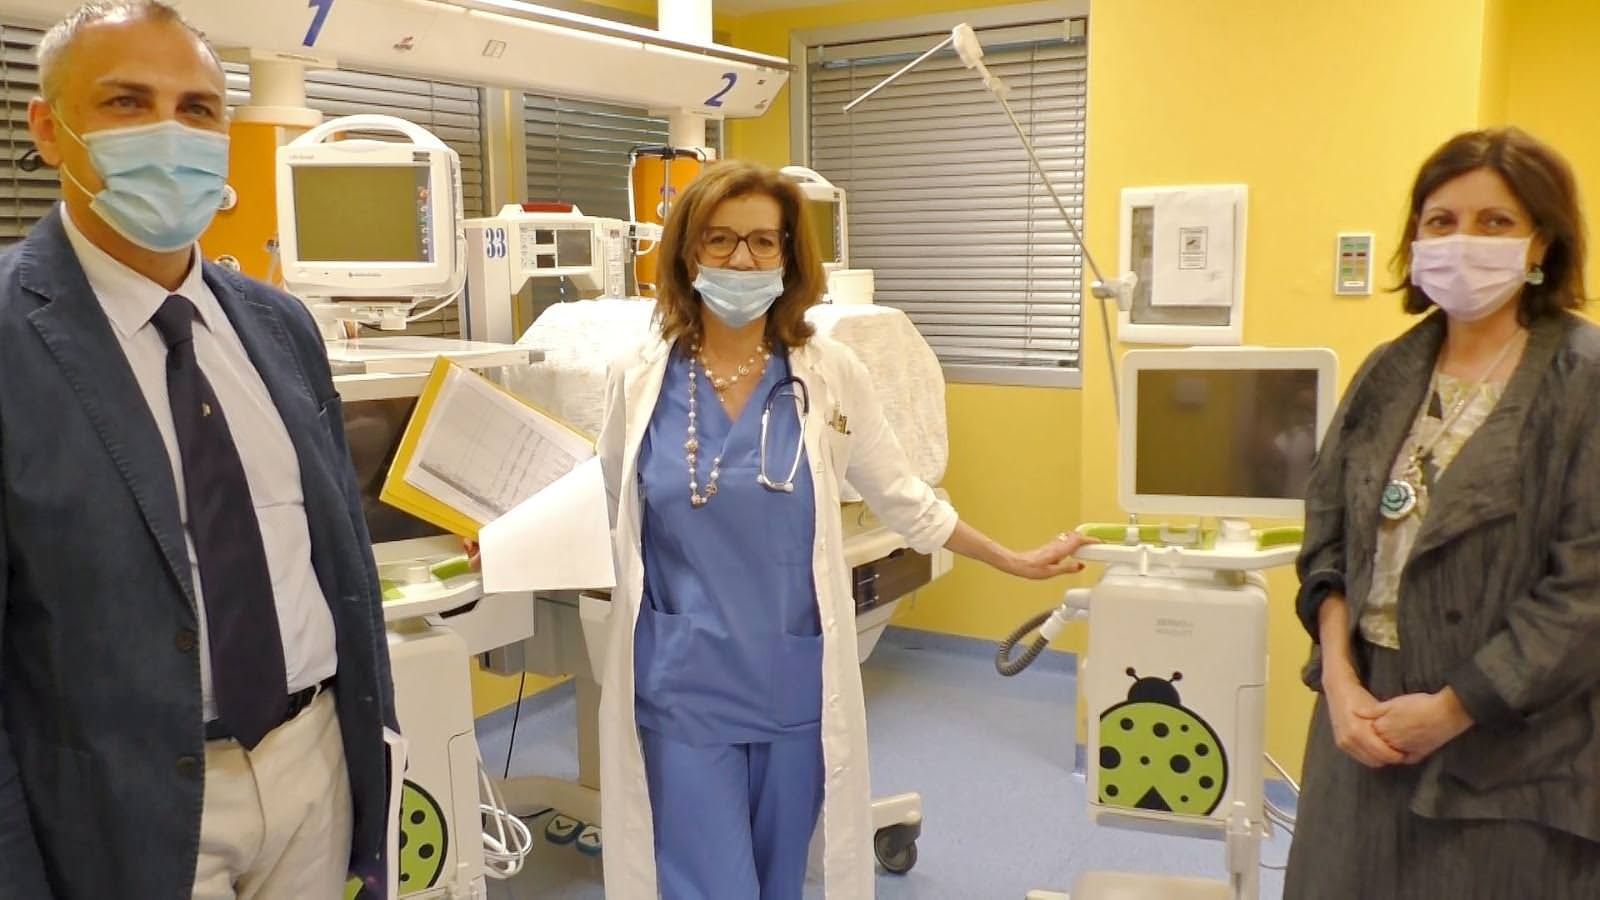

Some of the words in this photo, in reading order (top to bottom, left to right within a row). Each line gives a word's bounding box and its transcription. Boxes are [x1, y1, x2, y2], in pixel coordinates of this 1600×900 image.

[302, 0, 334, 46] 1
[704, 72, 737, 107] 2
[486, 227, 507, 258] 33
